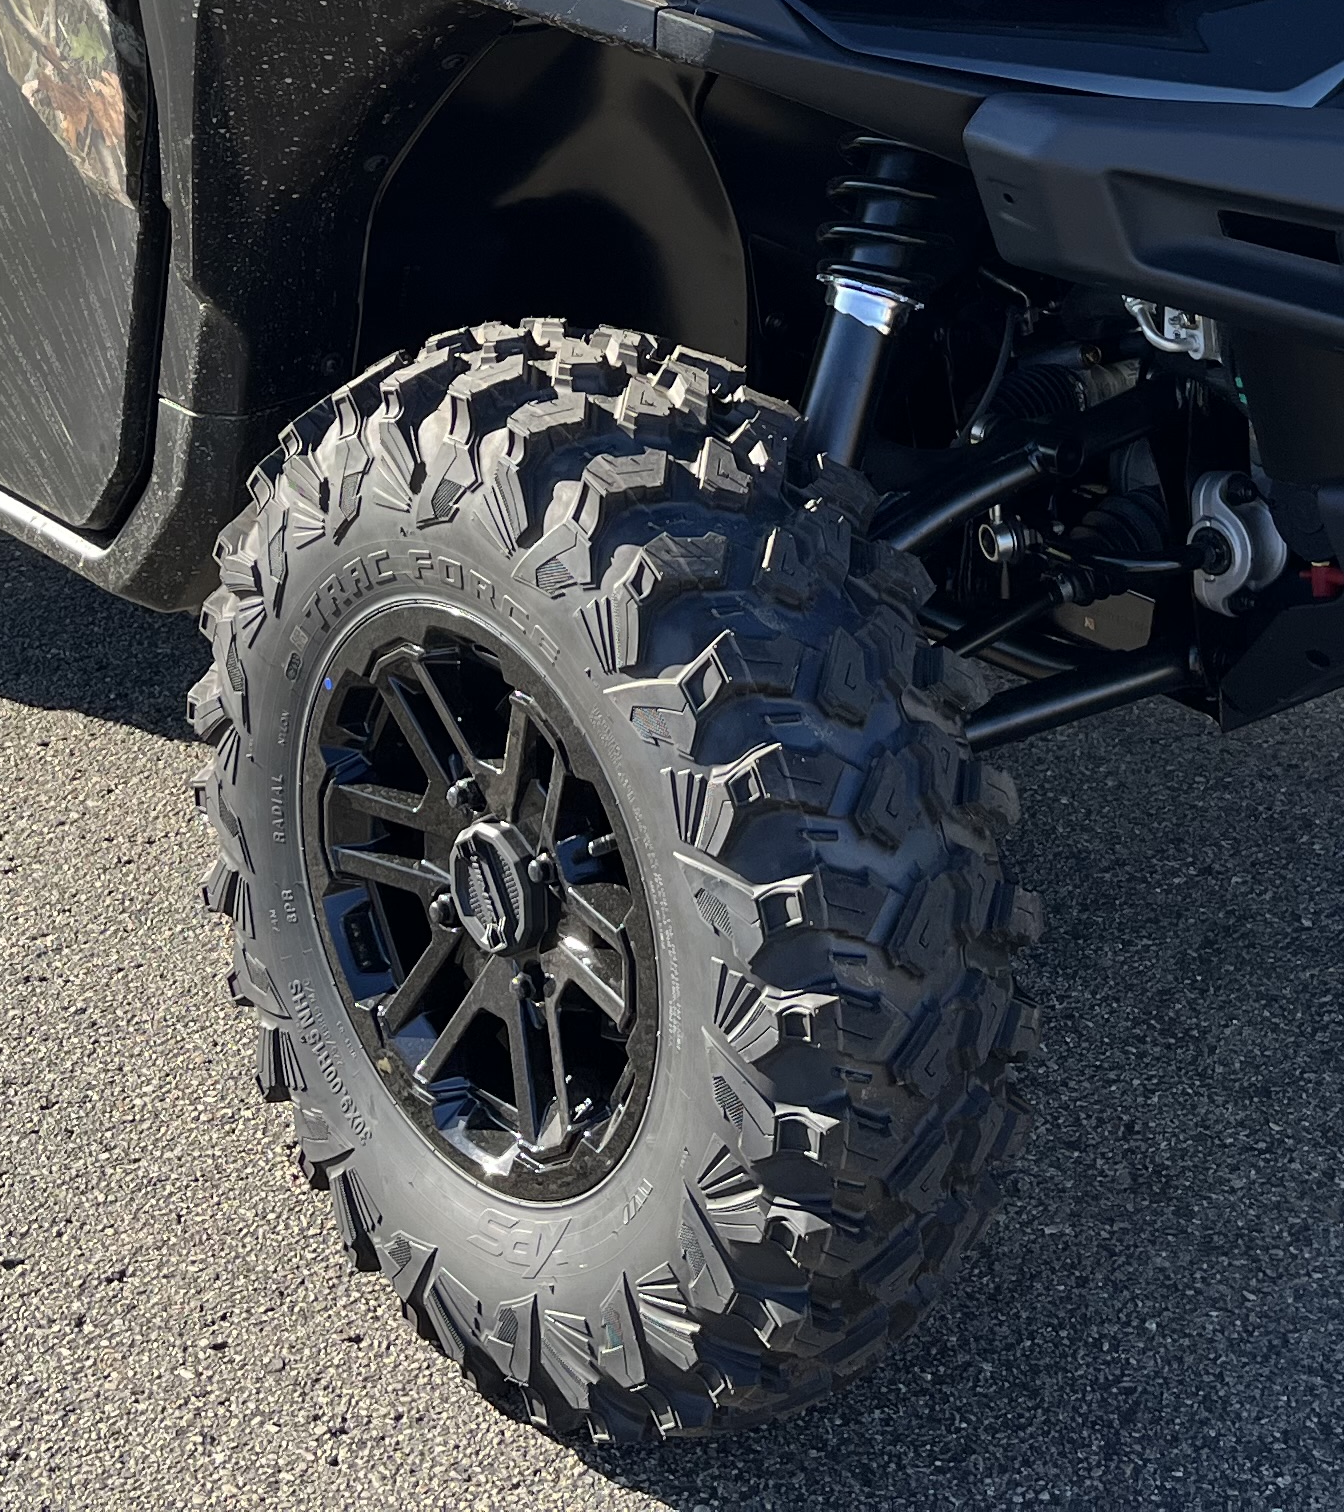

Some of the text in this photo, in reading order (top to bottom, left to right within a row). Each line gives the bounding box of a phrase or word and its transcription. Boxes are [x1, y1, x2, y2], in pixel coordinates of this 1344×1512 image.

[300, 548, 562, 667] TRAC FORCE
[270, 773, 287, 844] RADIAL
[288, 978, 317, 1029] NHS
